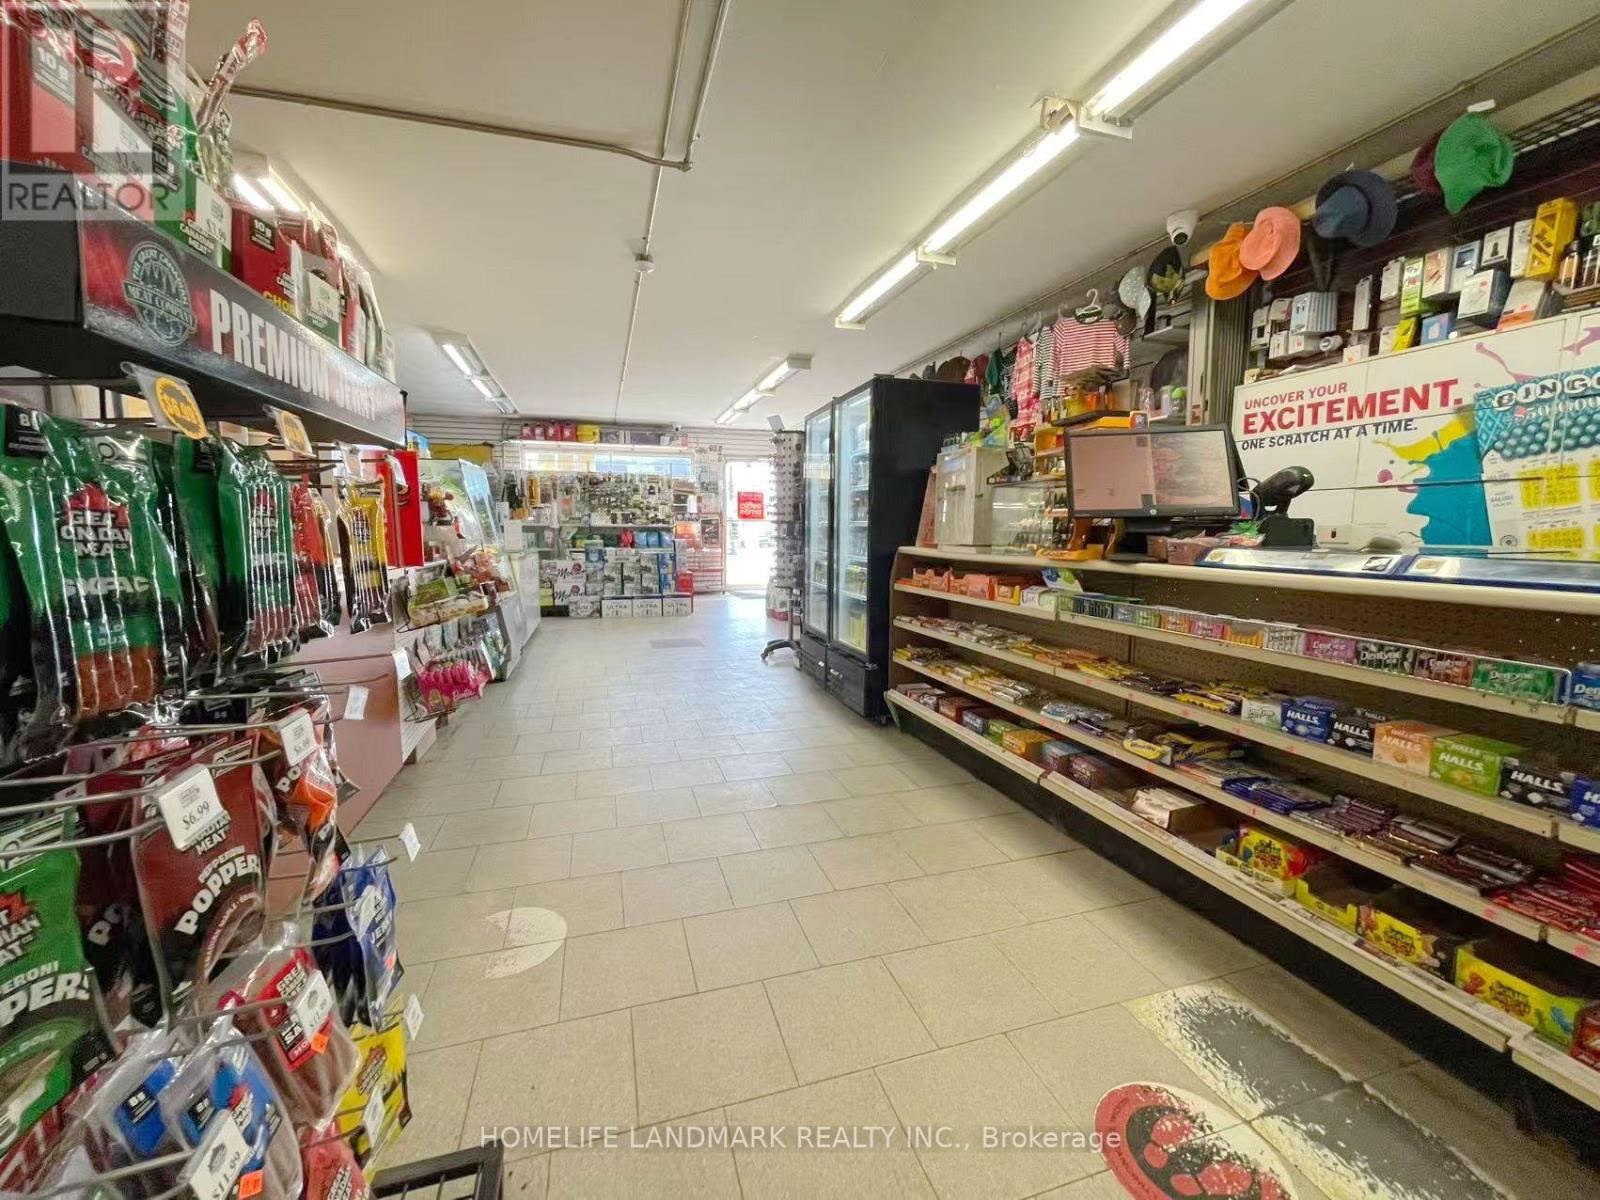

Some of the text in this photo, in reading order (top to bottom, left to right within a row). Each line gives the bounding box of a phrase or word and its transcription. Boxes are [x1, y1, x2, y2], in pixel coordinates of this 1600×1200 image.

[1243, 378, 1464, 436] EXCITEMENT.
[1244, 381, 1348, 411] UNCOVER YOUR
[1241, 418, 1419, 451] ONE SCRATCH AT A TIME.
[1438, 751, 1485, 773] HALLS
[182, 800, 211, 831] $6.99
[194, 830, 228, 856] MEAT
